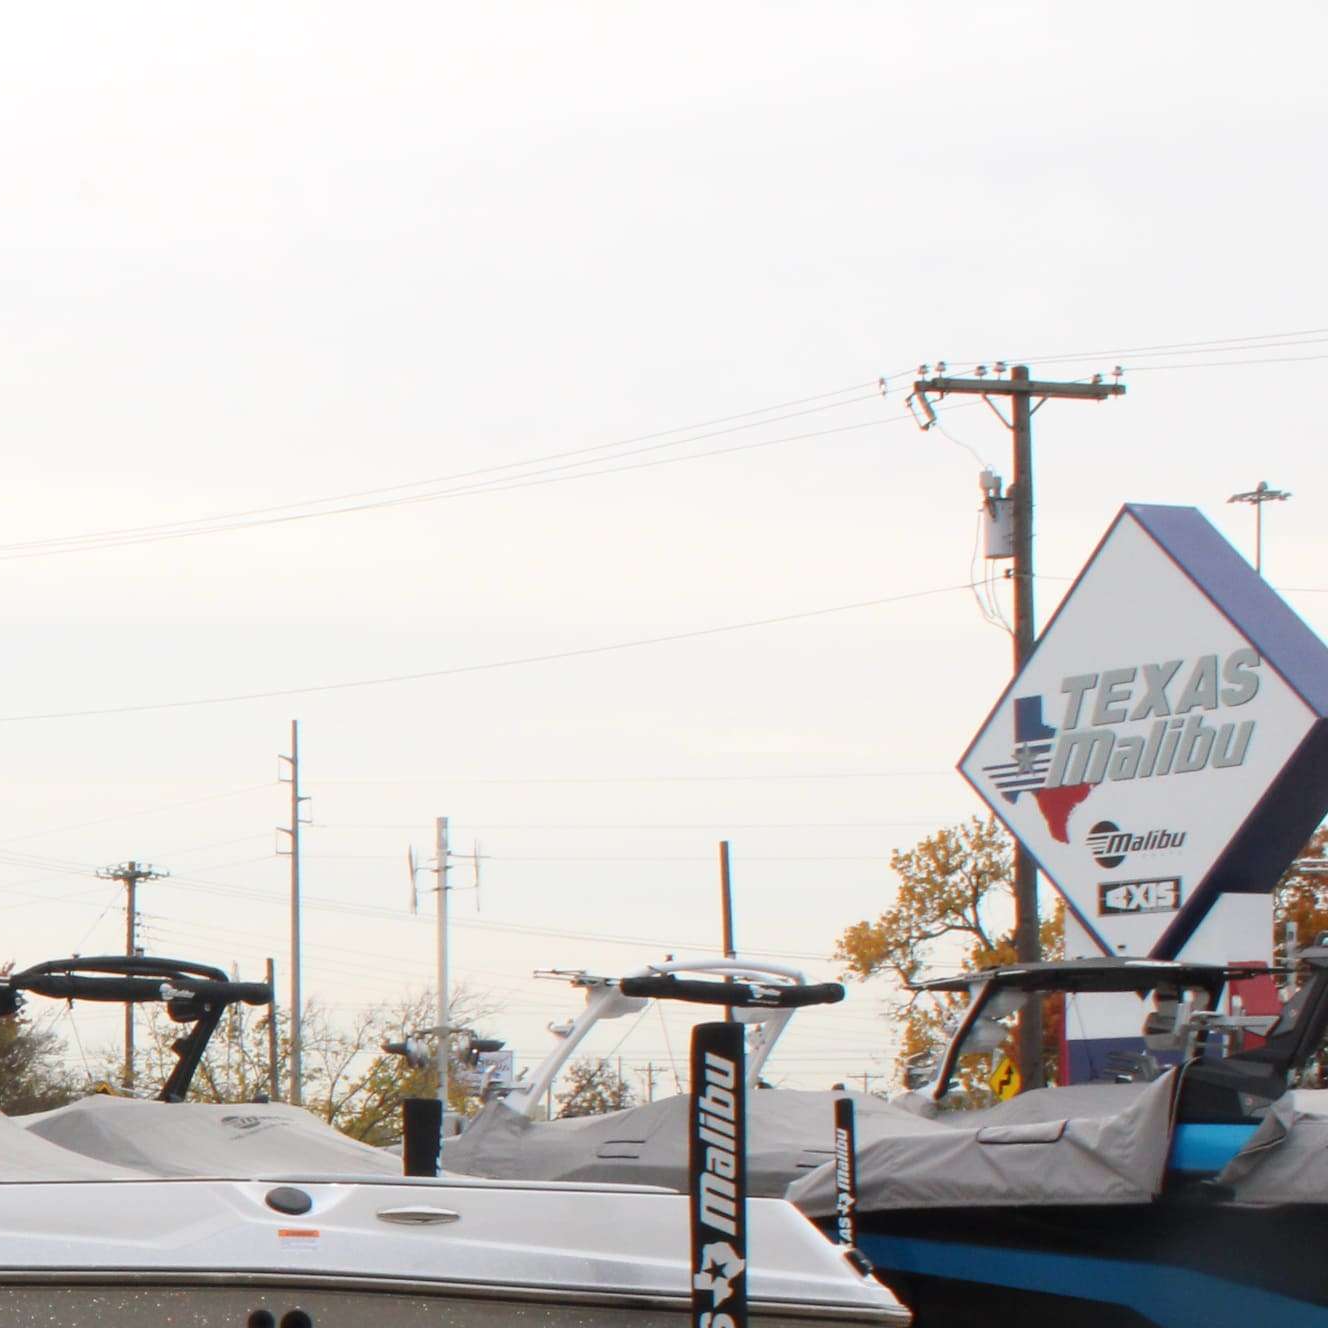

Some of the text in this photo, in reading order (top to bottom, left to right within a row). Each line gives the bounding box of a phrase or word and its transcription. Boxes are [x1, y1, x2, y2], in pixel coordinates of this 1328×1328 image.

[1060, 648, 1261, 731] TEXAS
[1044, 715, 1256, 789] Malibu
[1106, 829, 1186, 853] Malibu
[1105, 880, 1173, 909] AXIS
[698, 1051, 737, 1237] Malibu
